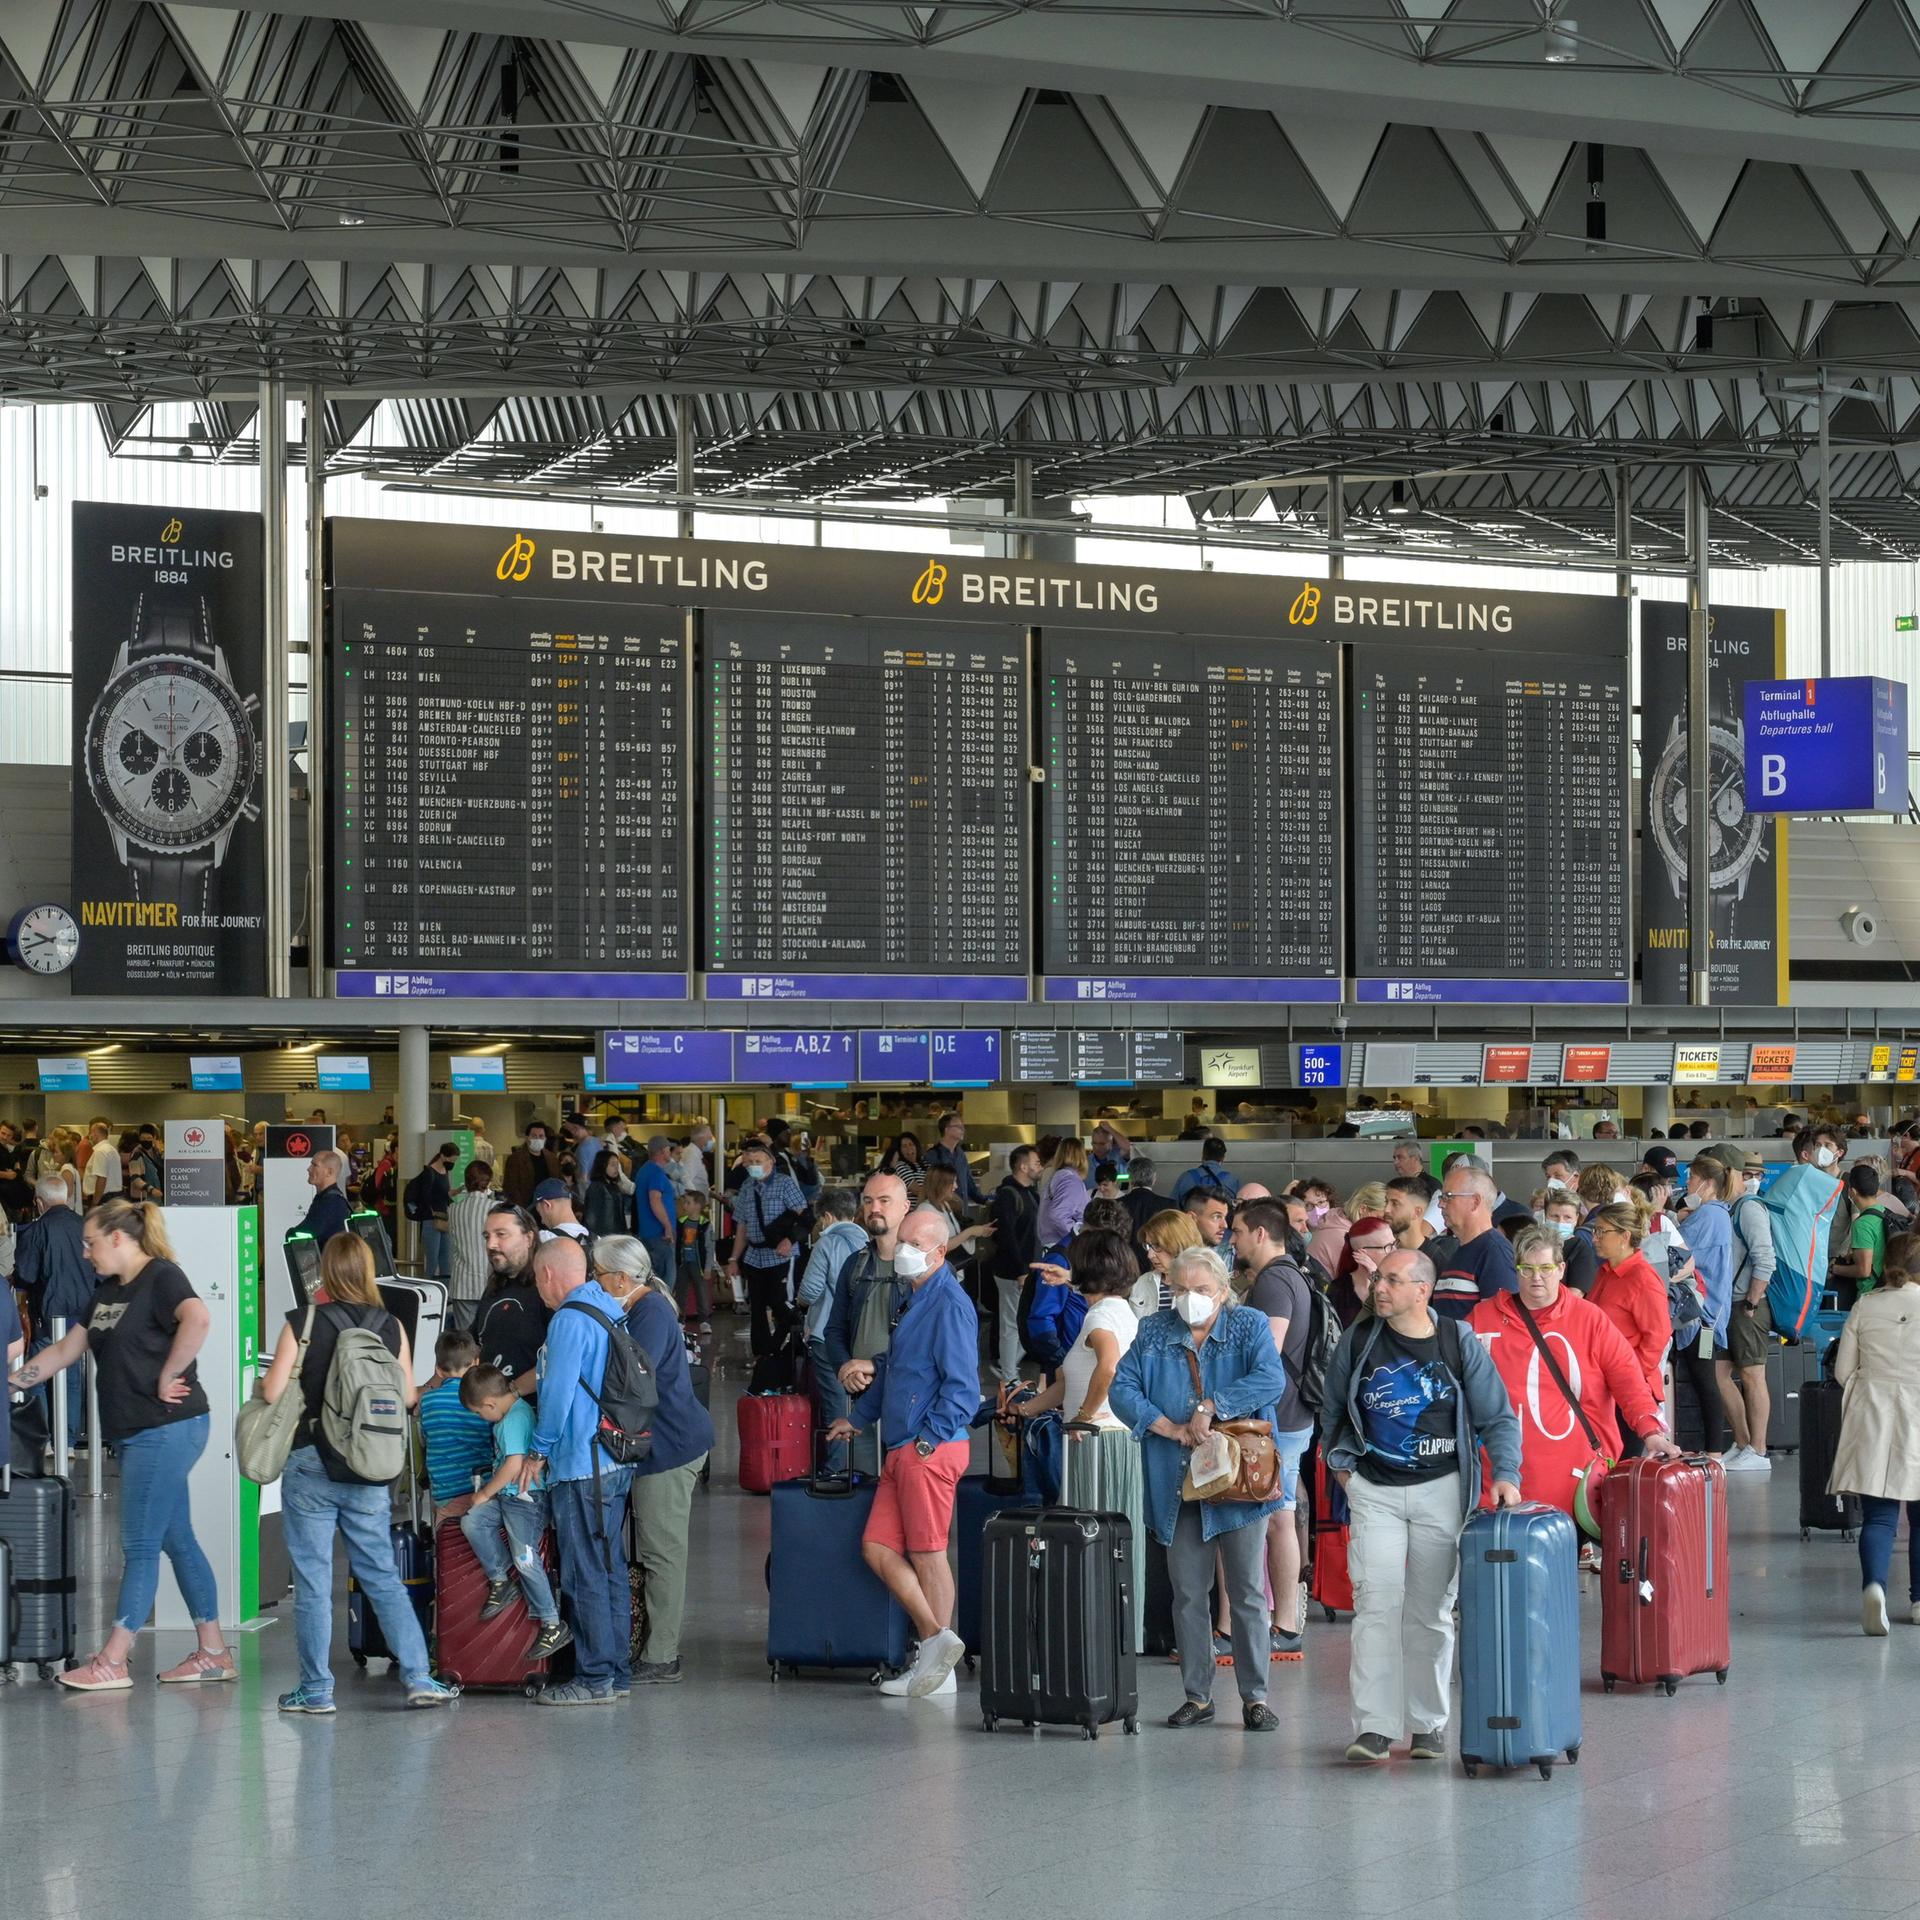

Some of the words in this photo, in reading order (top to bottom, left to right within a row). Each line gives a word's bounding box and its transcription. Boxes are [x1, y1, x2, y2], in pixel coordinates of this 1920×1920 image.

[112, 546, 233, 568] BREITLING
[552, 548, 768, 592] BREITLING
[155, 570, 188, 584] 1884
[962, 574, 1158, 613] BREITLING
[1333, 595, 1513, 633] BREITLING
[1667, 637, 1750, 655] BRLING
[419, 648, 434, 657] KOS
[419, 673, 440, 682] WIEN
[781, 677, 811, 686] DUBLIN
[1114, 680, 1126, 690] TEL
[1132, 682, 1168, 692] AVIV-BEN
[1172, 683, 1199, 693] GURION
[781, 689, 816, 698] HOUSTON
[1760, 690, 1800, 701] Terminal
[1808, 689, 1812, 700] 1
[1114, 704, 1145, 713] VILNIUS
[781, 712, 811, 722] BERGEN
[1141, 716, 1149, 724] DE
[1760, 709, 1815, 722] Abflughalle
[419, 723, 520, 735] AMSTERDAM-CANCELLED
[1760, 724, 1811, 737] Departures
[1815, 723, 1833, 734] hall
[419, 735, 500, 747] TORONTO-PEARSON
[1114, 738, 1127, 746] SAN
[1132, 739, 1173, 748] FRANCISCO
[419, 748, 478, 758] DUESSELDORF
[484, 750, 499, 759] HBF
[782, 748, 826, 758] NUERNBERG
[1114, 750, 1150, 759] WARSCHAU
[1420, 749, 1457, 758] CHARLOTTE
[419, 760, 466, 770] STUTTGART
[473, 762, 488, 771] HBF
[1420, 760, 1445, 769] DUBLIN
[419, 772, 456, 782] SEVILLA
[782, 772, 811, 781] ZAGREB
[1762, 754, 1786, 796] B
[1878, 753, 1885, 794] B
[420, 785, 446, 794] IBIZA
[782, 784, 826, 793] STUTTGART
[831, 786, 845, 794] HBF
[1114, 783, 1127, 792] LOS
[1132, 784, 1164, 793] ANGELES
[782, 796, 807, 805] KOELN
[812, 797, 826, 805] HBF
[419, 810, 457, 820] ZUERICH
[1114, 806, 1182, 816] LONDON-HEATHROW
[1114, 818, 1137, 826] NIZZA
[1420, 815, 1458, 823] BARCELONA
[419, 822, 451, 832] BODRUM
[782, 820, 811, 829] NEAPEL
[782, 832, 836, 842] DALLAS-FORT
[1114, 829, 1142, 838] RIJEKA
[419, 835, 505, 846] BERLIN-CANCELLED
[782, 844, 807, 853] KAIRO
[419, 860, 462, 870] VALENCIA
[782, 856, 821, 865] BORDEAUX
[1421, 859, 1470, 868] THESSALONIKI
[782, 868, 816, 877] FUNCHAL
[783, 879, 802, 888] FARO
[1421, 881, 1450, 889] LARNACA
[419, 885, 516, 896] KOPENHAGEN-KASTRUP
[1114, 886, 1146, 895] DETROIT
[782, 891, 826, 900] VANCOUVER
[1421, 903, 1442, 911] LAGOS
[82, 902, 178, 927] NAVITIMER
[182, 916, 199, 927] FOR
[203, 916, 219, 927] THE
[221, 916, 261, 928] JOURNEY
[1114, 909, 1142, 918] BEIRUT
[419, 922, 441, 931] WIEN
[782, 927, 817, 936] ATLANTA
[782, 939, 866, 949] STOCKHOLM-ARLANDA
[1421, 936, 1446, 944] TAIPEH
[1114, 944, 1196, 953] BERLIN-BRANDENBURG
[1717, 940, 1728, 949] FOR
[1743, 940, 1770, 950] JOURNEY
[127, 944, 170, 956] BREITLING
[173, 945, 214, 957] BOUTIQUE
[782, 951, 807, 960] SOFIA
[1711, 964, 1739, 973] BOUTIQUE
[412, 976, 432, 985] Abflug
[775, 978, 794, 988] Abflug
[1108, 981, 1125, 990] Abflug
[1415, 983, 1431, 992] Abflug
[412, 987, 445, 996] Departures
[775, 989, 806, 998] Departures
[1108, 991, 1136, 999] Departures
[1415, 992, 1441, 1000] Departures
[641, 1036, 660, 1044] Abflug
[674, 1035, 683, 1053] C
[762, 1036, 780, 1044] Abflug
[795, 1035, 831, 1054] A,B,Z
[935, 1035, 956, 1054] D,E
[1680, 1052, 1718, 1061] TICKETS
[1304, 1057, 1330, 1069] 500-
[1304, 1072, 1324, 1083] 570
